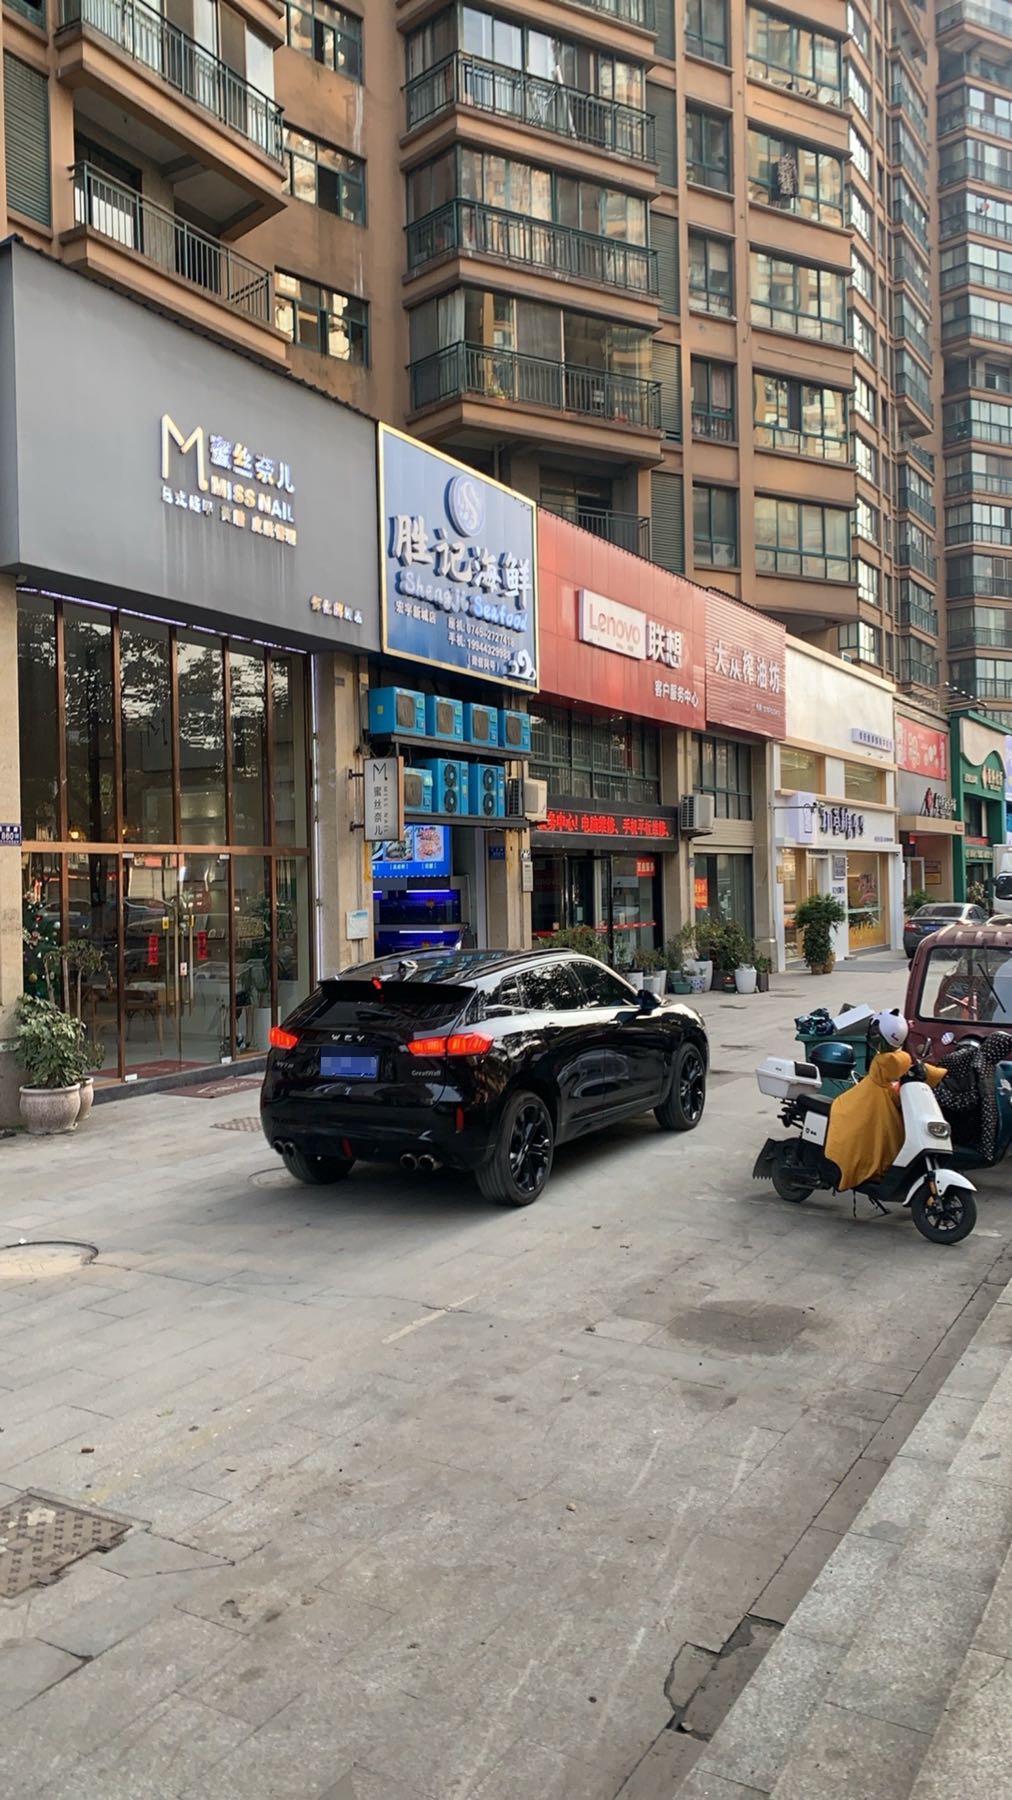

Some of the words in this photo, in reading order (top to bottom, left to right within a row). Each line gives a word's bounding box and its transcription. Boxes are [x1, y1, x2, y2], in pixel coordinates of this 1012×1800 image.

[210, 434, 295, 493] 蜜丝奈儿
[211, 475, 256, 507] MISS
[258, 493, 295, 522] NAIL
[391, 514, 532, 611] 胜记海鲜
[472, 595, 528, 632] Seafood
[589, 604, 641, 645] Lenovo
[648, 620, 683, 669] 联想
[654, 679, 699, 708] 客户服务中心
